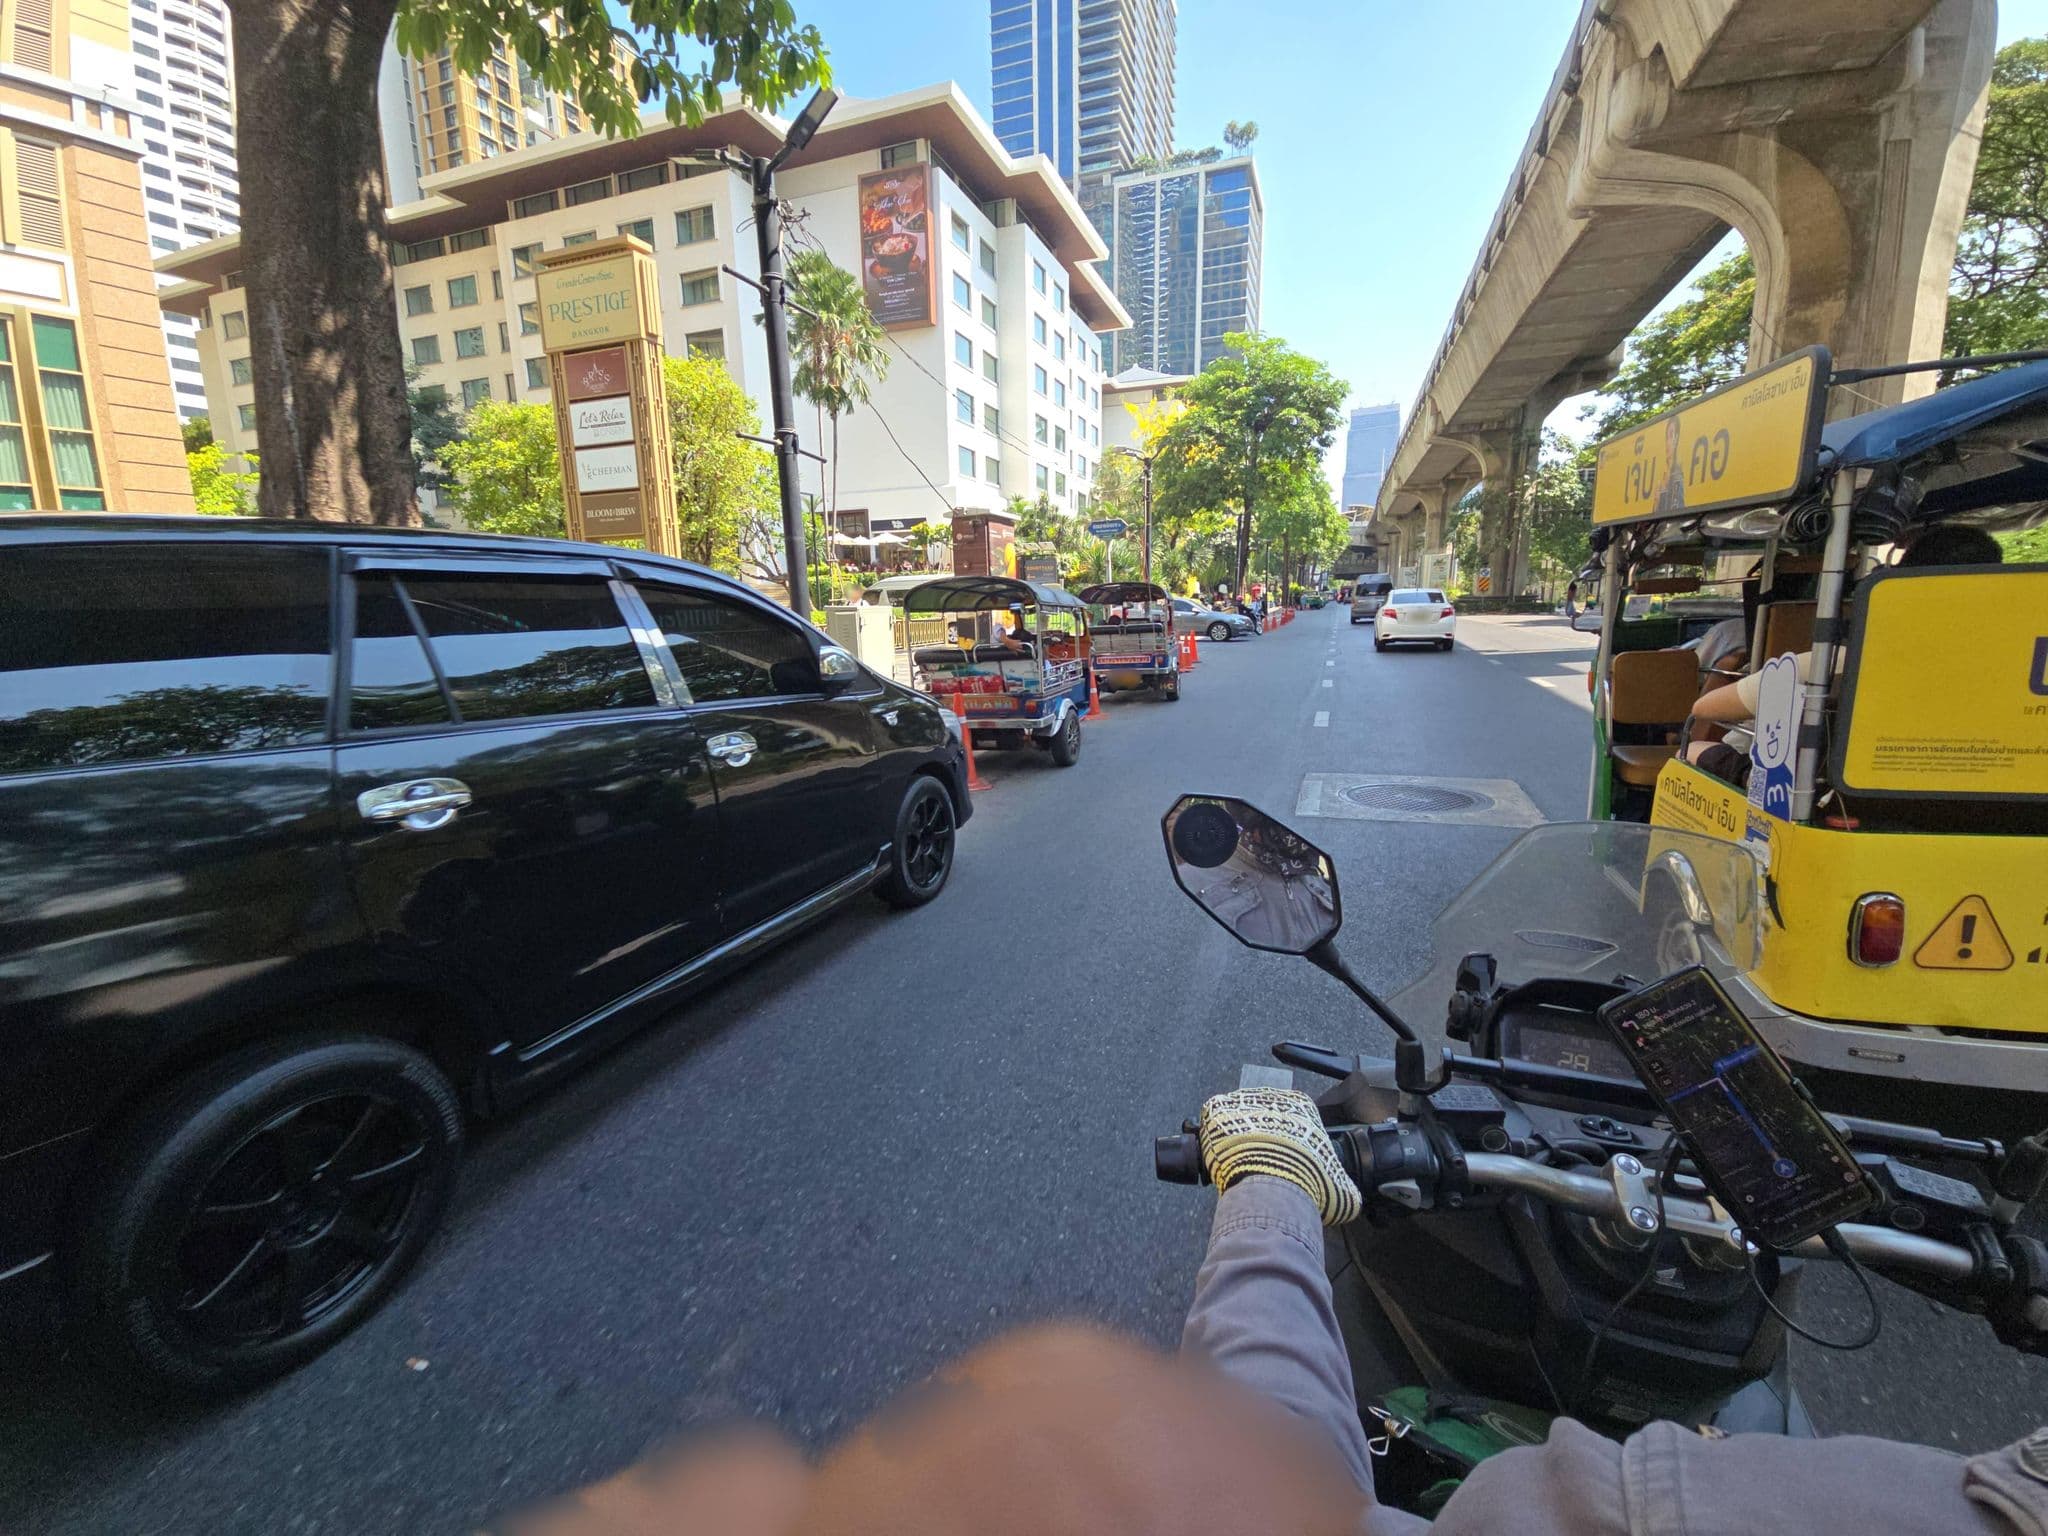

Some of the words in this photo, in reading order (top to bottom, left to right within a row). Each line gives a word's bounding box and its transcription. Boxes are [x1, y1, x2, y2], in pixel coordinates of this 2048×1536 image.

[547, 289, 632, 324] PRESTIGE
[571, 325, 610, 339] BANGKOK
[1688, 428, 1730, 487] คอ
[592, 464, 633, 477] CHEFMAN
[1557, 1050, 1590, 1072] 29
